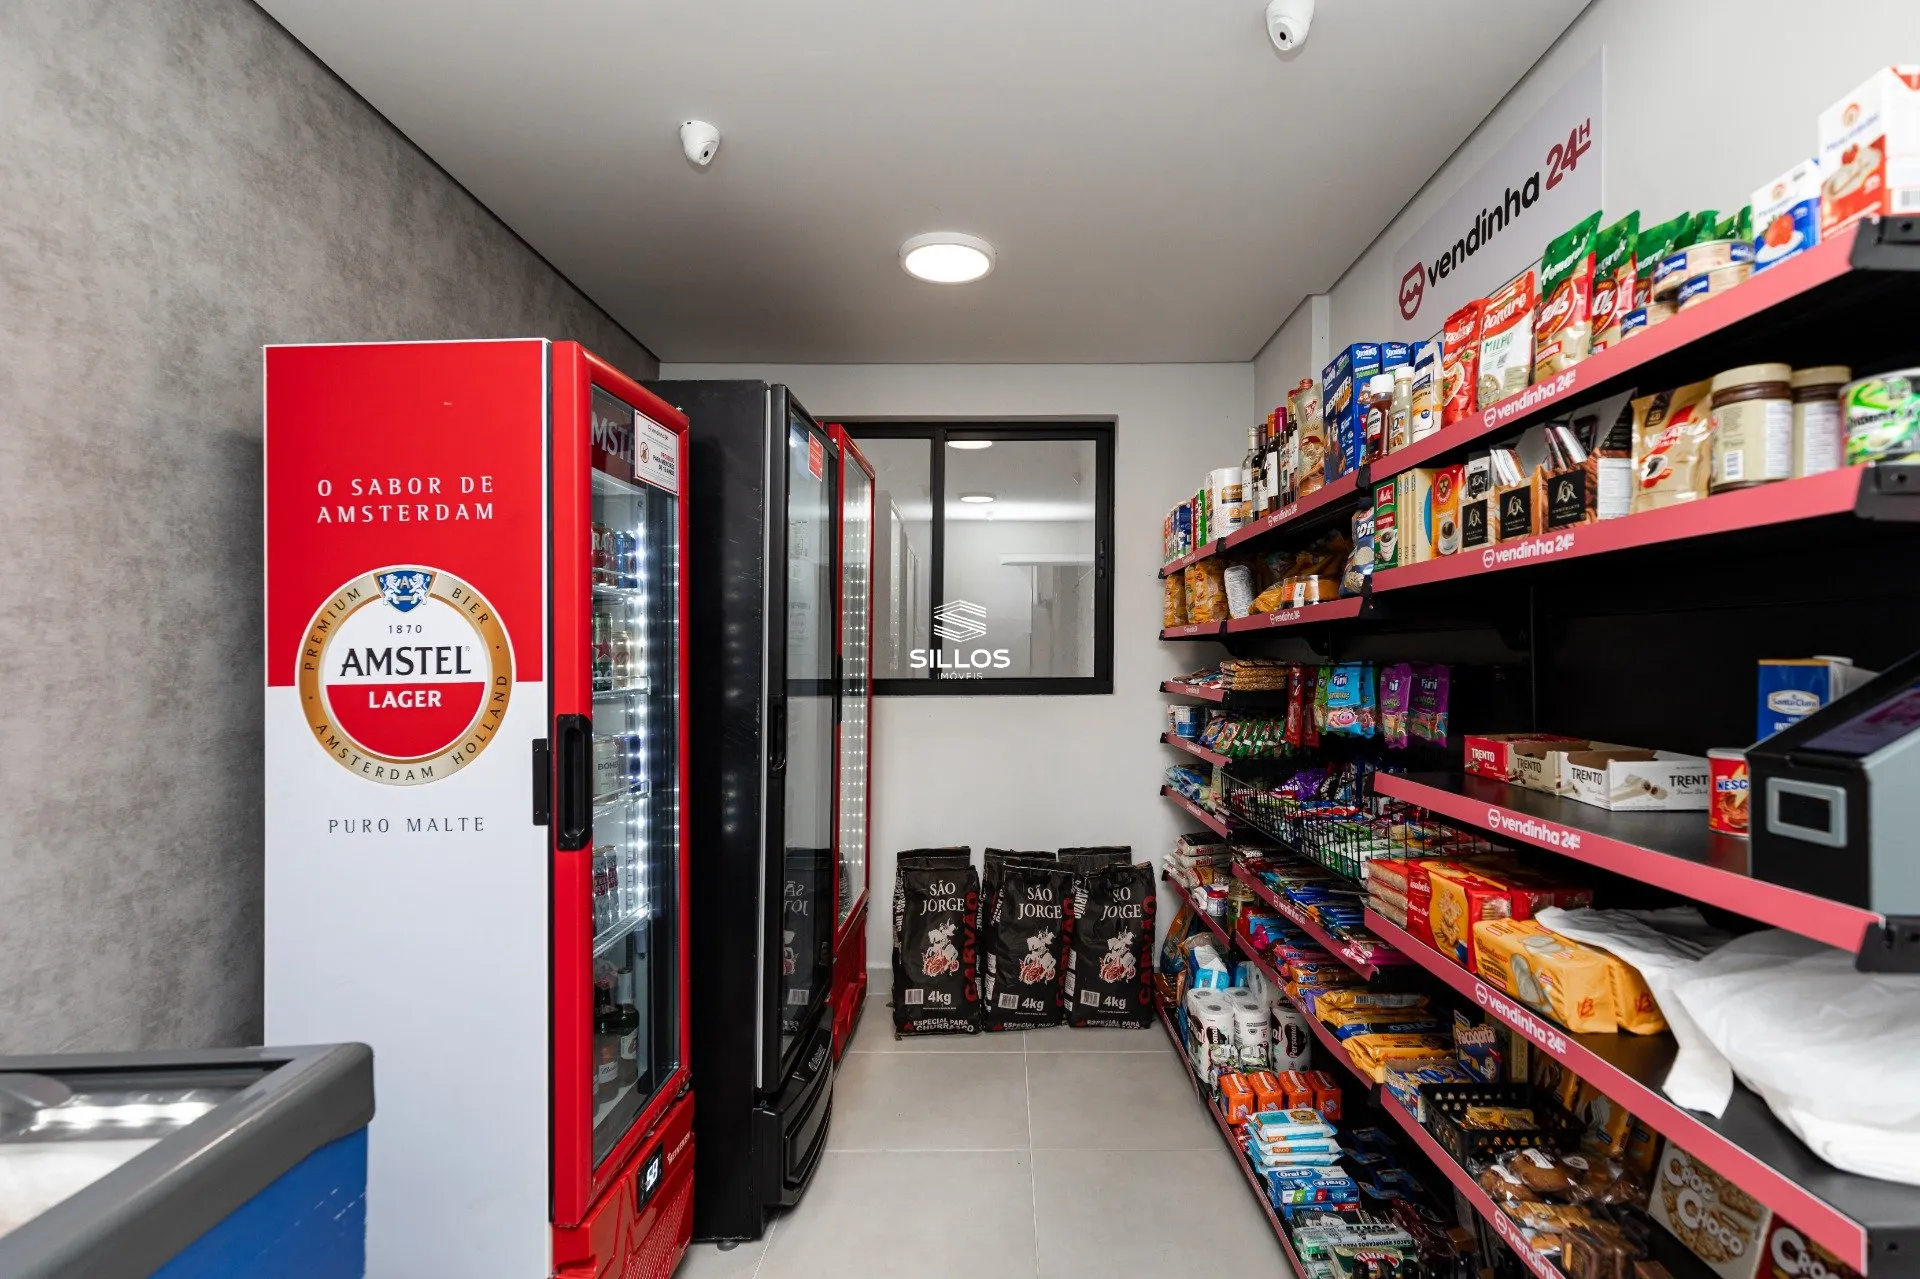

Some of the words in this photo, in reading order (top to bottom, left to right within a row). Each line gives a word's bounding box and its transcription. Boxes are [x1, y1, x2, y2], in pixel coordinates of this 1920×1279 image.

[1428, 172, 1540, 287] vendinha
[1497, 383, 1556, 420] vendinha
[317, 479, 332, 497] O
[351, 476, 442, 496] SABOR
[461, 475, 494, 493] DE
[317, 502, 495, 524] AMSTERDAM
[1494, 541, 1554, 563] vendinha
[304, 587, 362, 672] PREMIUM
[451, 587, 490, 625] BIER
[388, 623, 422, 635] 1870
[339, 645, 473, 677] AMSTEL
[1333, 673, 1348, 686] Fini
[1421, 678, 1437, 690] Fini
[368, 690, 442, 709] LAGER
[316, 722, 434, 782] AMSTERDAM
[452, 674, 508, 765] HOLLAND
[1471, 747, 1495, 763] TRENTO
[1516, 757, 1542, 773] TRENTO
[1571, 767, 1603, 785] TRENTO
[328, 817, 390, 834] PURO
[406, 816, 485, 832] MALTE
[1501, 816, 1560, 846] vendinha
[930, 880, 955, 896] SÃO
[1027, 885, 1052, 901] SÃO
[920, 898, 965, 915] JORGE
[1017, 904, 1063, 919] JORGE
[963, 892, 978, 1002] CARVÃO
[928, 990, 951, 1005] 4kg
[1022, 998, 1044, 1011] 4kg
[1103, 996, 1126, 1009] 4kg
[913, 1018, 948, 1026] ESPECIAL
[1488, 995, 1546, 1044] vendinha
[1289, 1022, 1298, 1058] Personal
[1281, 1170, 1309, 1178] Oral-B
[1664, 1149, 1715, 1200] CROC
[1676, 1188, 1744, 1255] CHOCO
